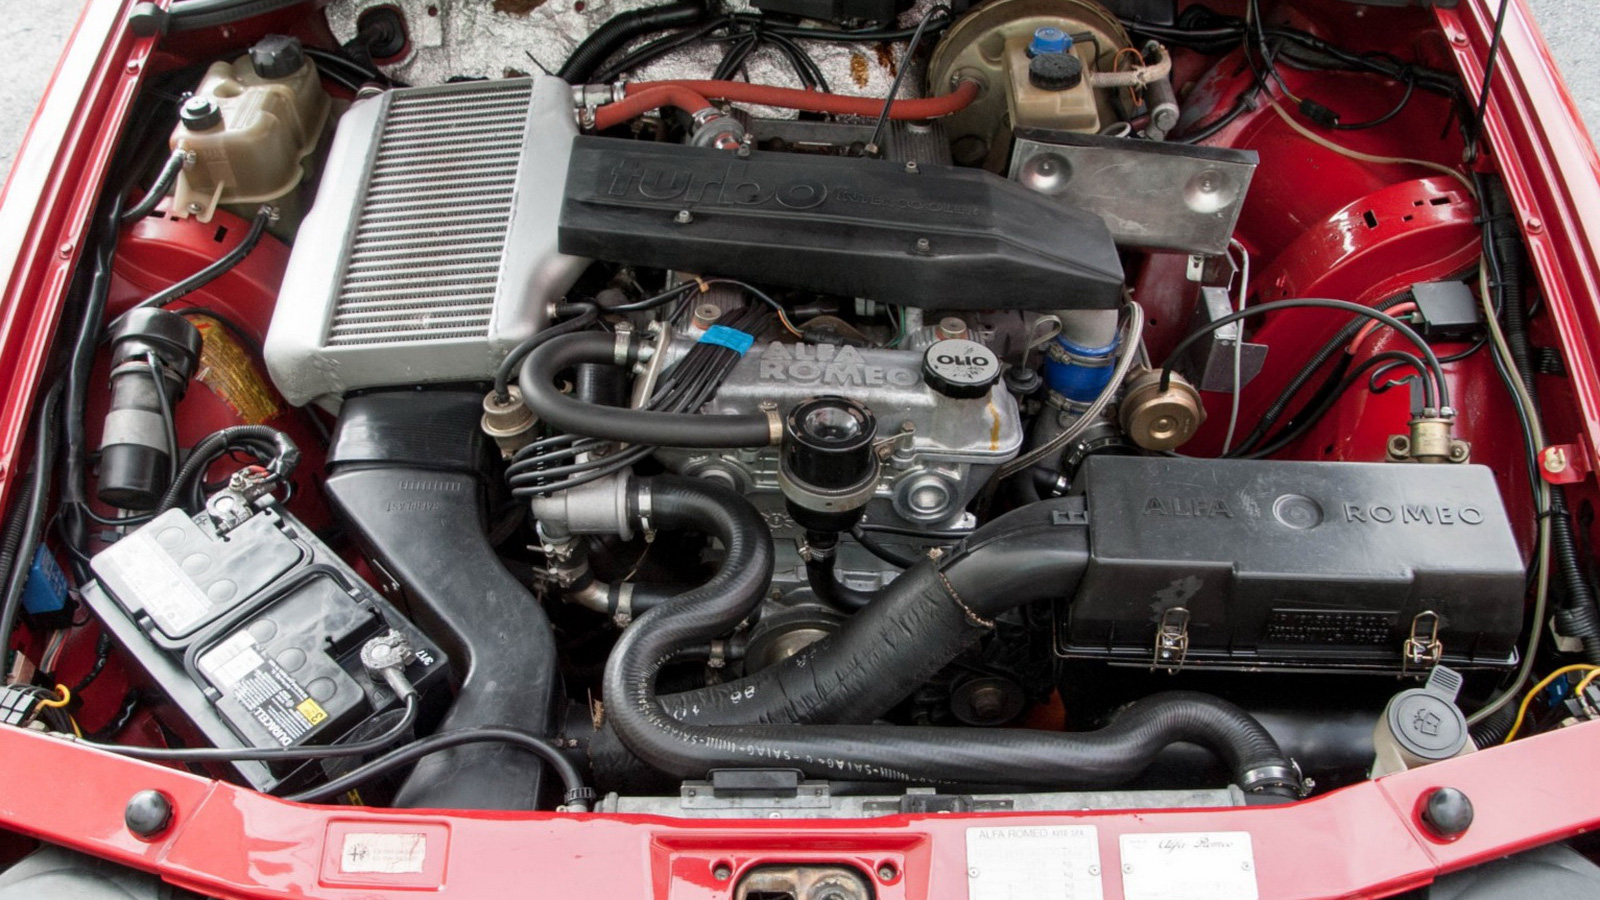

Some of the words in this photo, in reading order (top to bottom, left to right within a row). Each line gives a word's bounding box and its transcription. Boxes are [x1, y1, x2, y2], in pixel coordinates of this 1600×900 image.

[760, 340, 866, 364] ALFA
[937, 354, 989, 367] OLIO
[759, 359, 920, 388] ROMEO
[1143, 496, 1234, 519] ALFA
[1342, 503, 1485, 526] ROMEO
[253, 706, 293, 747] DURACELL
[979, 829, 1005, 840] ALFA
[1008, 828, 1048, 839] ROMEO
